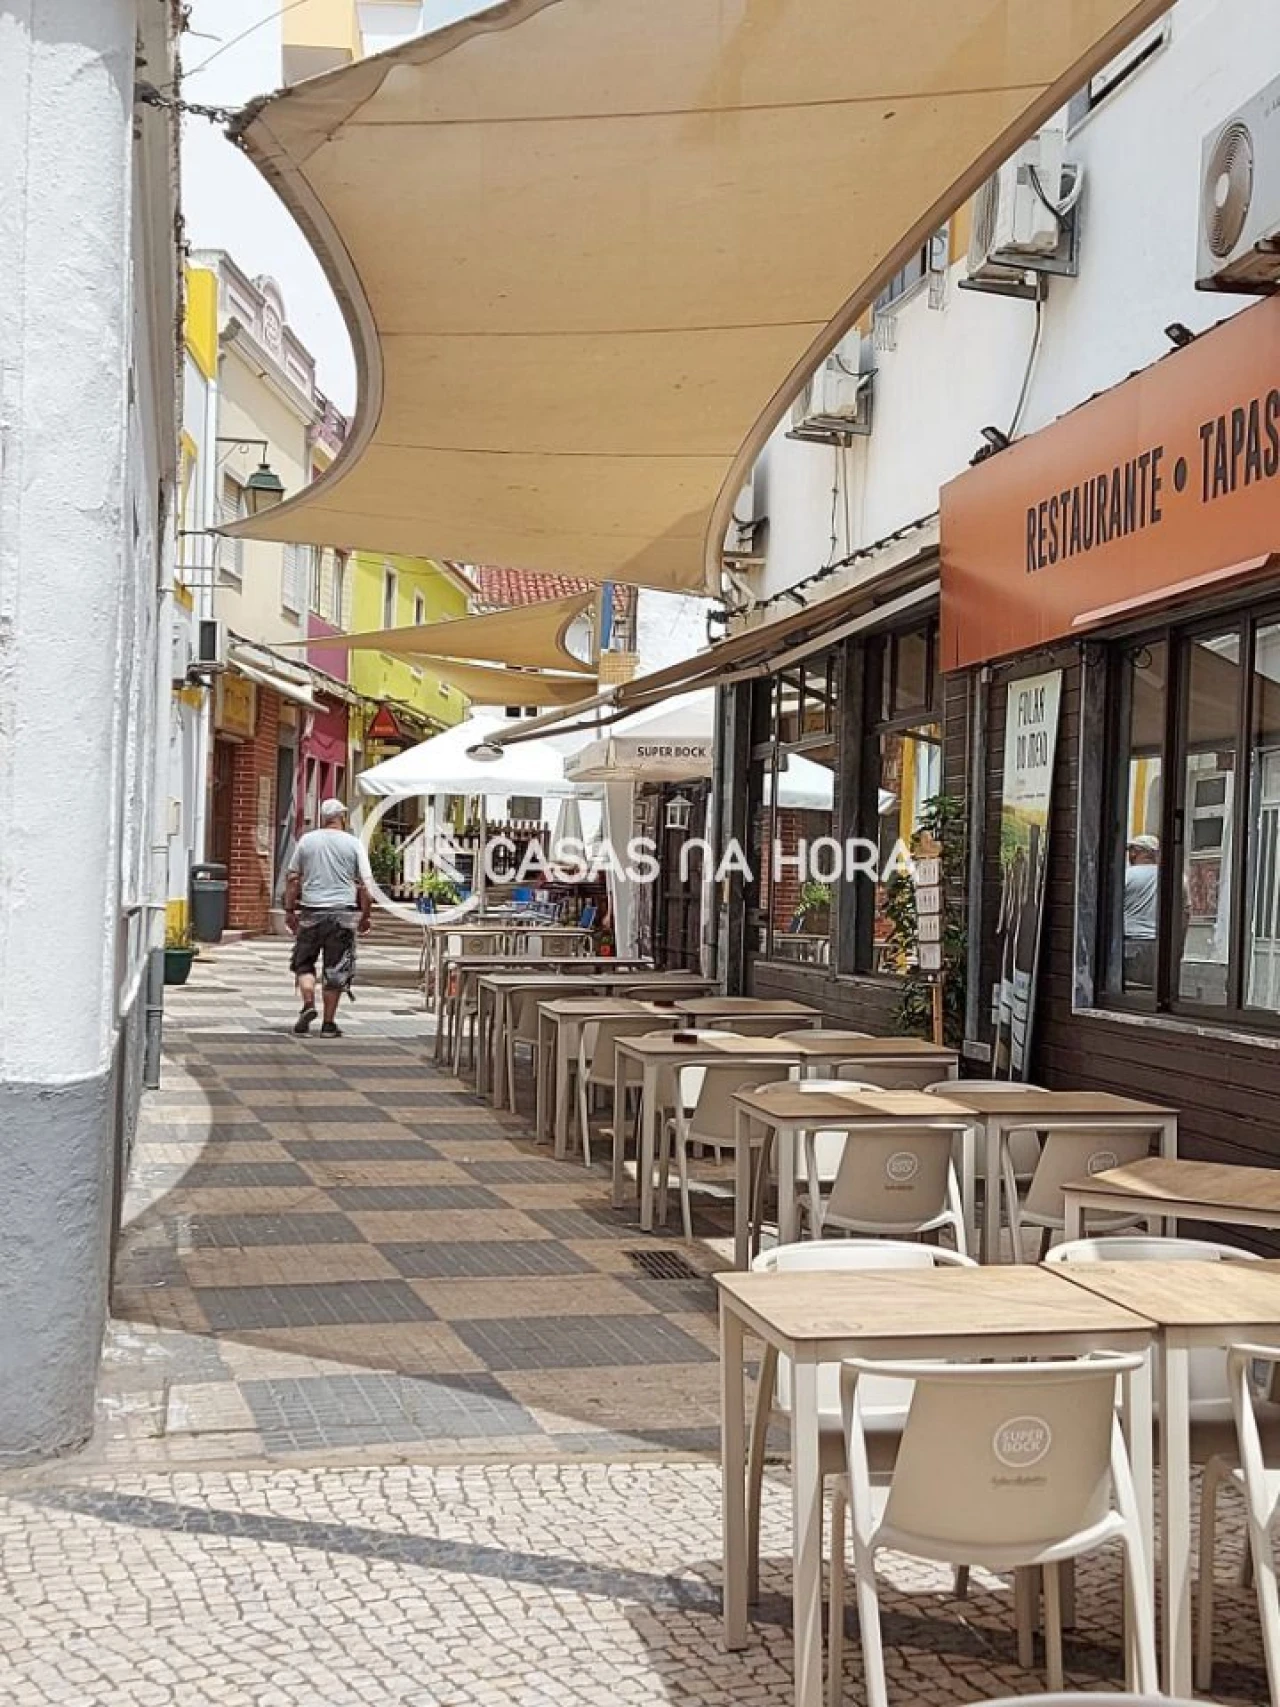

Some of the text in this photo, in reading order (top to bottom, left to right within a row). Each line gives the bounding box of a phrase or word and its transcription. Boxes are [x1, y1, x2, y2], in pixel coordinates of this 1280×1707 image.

[1026, 389, 1280, 574] RESTAURANTE TAPAS
[637, 746, 707, 757] SUPER BOCK
[1001, 1428, 1045, 1443] SUPER
[1002, 1441, 1041, 1453] BOCK
